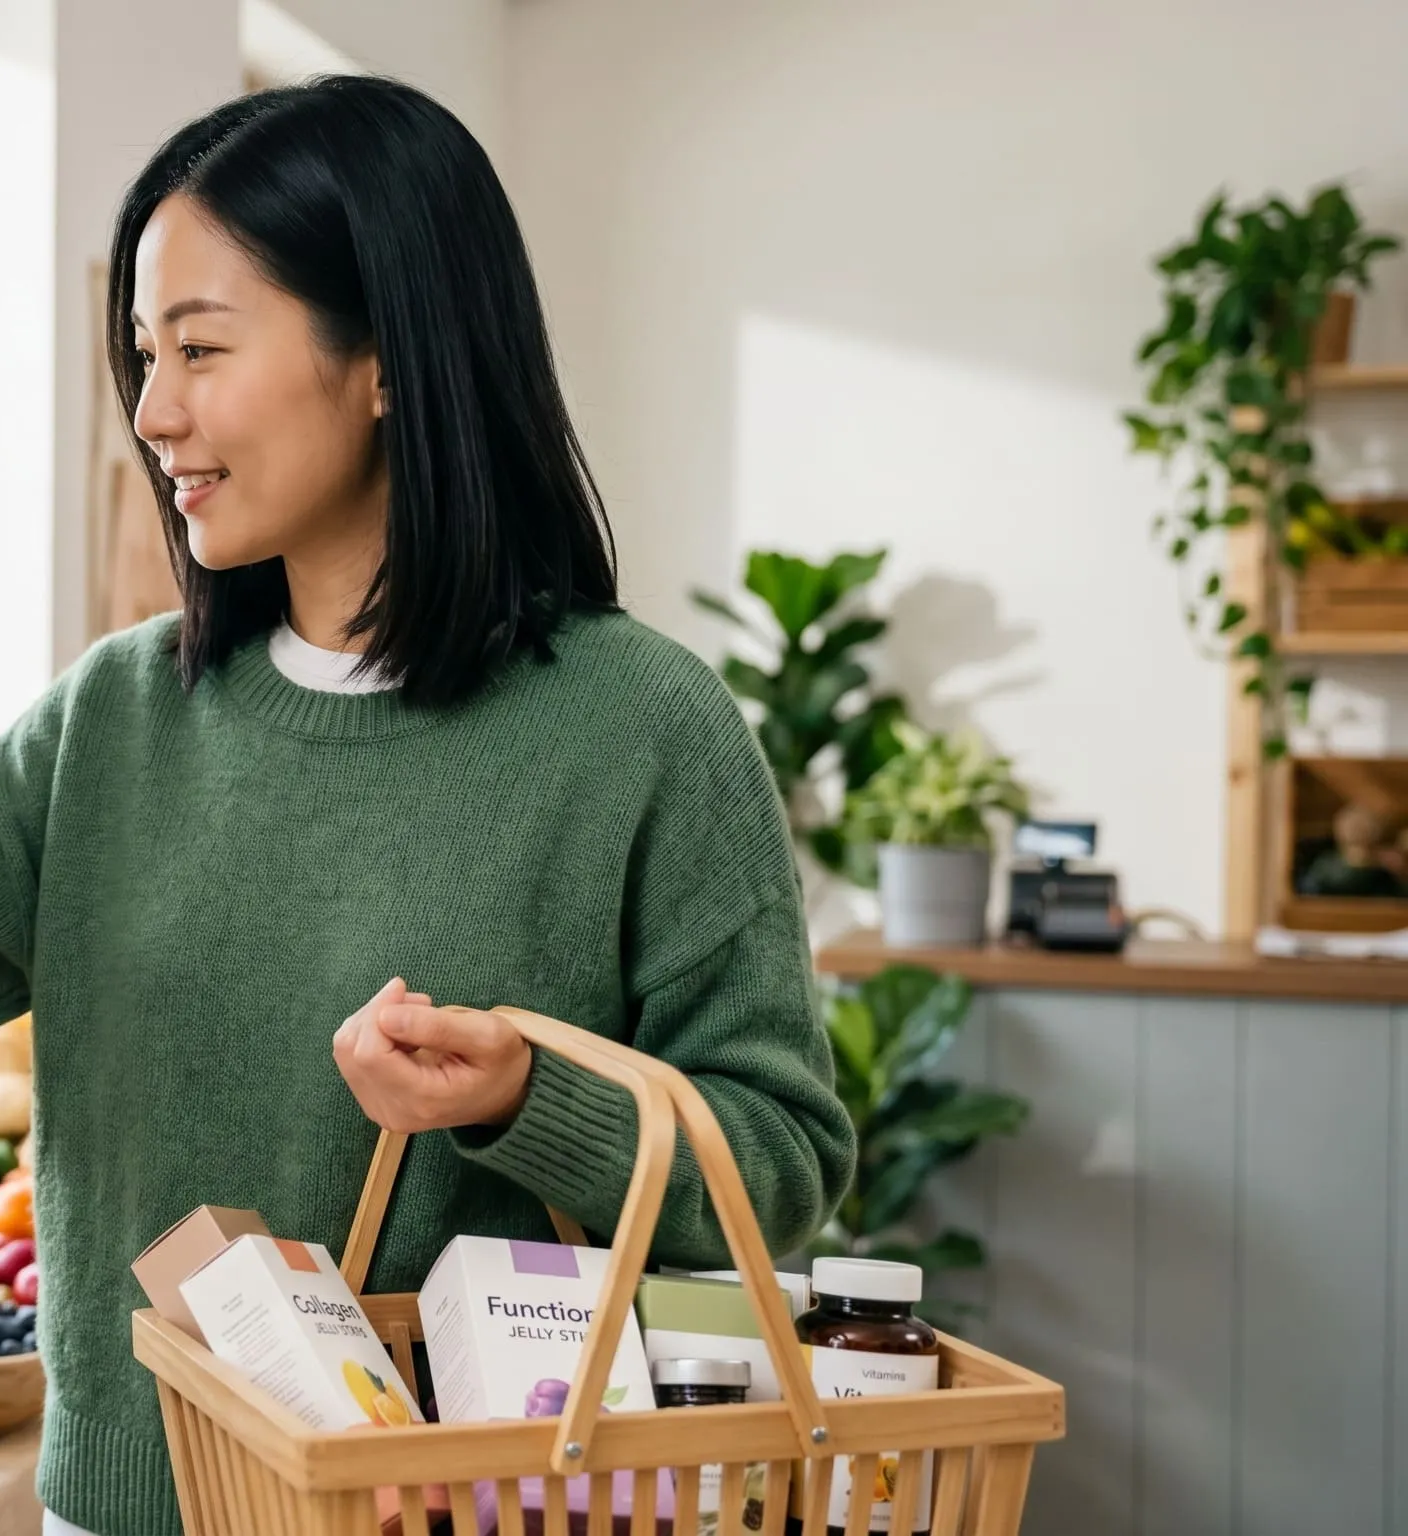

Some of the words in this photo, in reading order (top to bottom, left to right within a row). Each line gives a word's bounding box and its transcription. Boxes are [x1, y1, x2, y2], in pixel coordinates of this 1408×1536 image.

[293, 1294, 360, 1322] Collagen
[509, 1325, 553, 1341] JELLY
[862, 1369, 906, 1382] Vitamins
